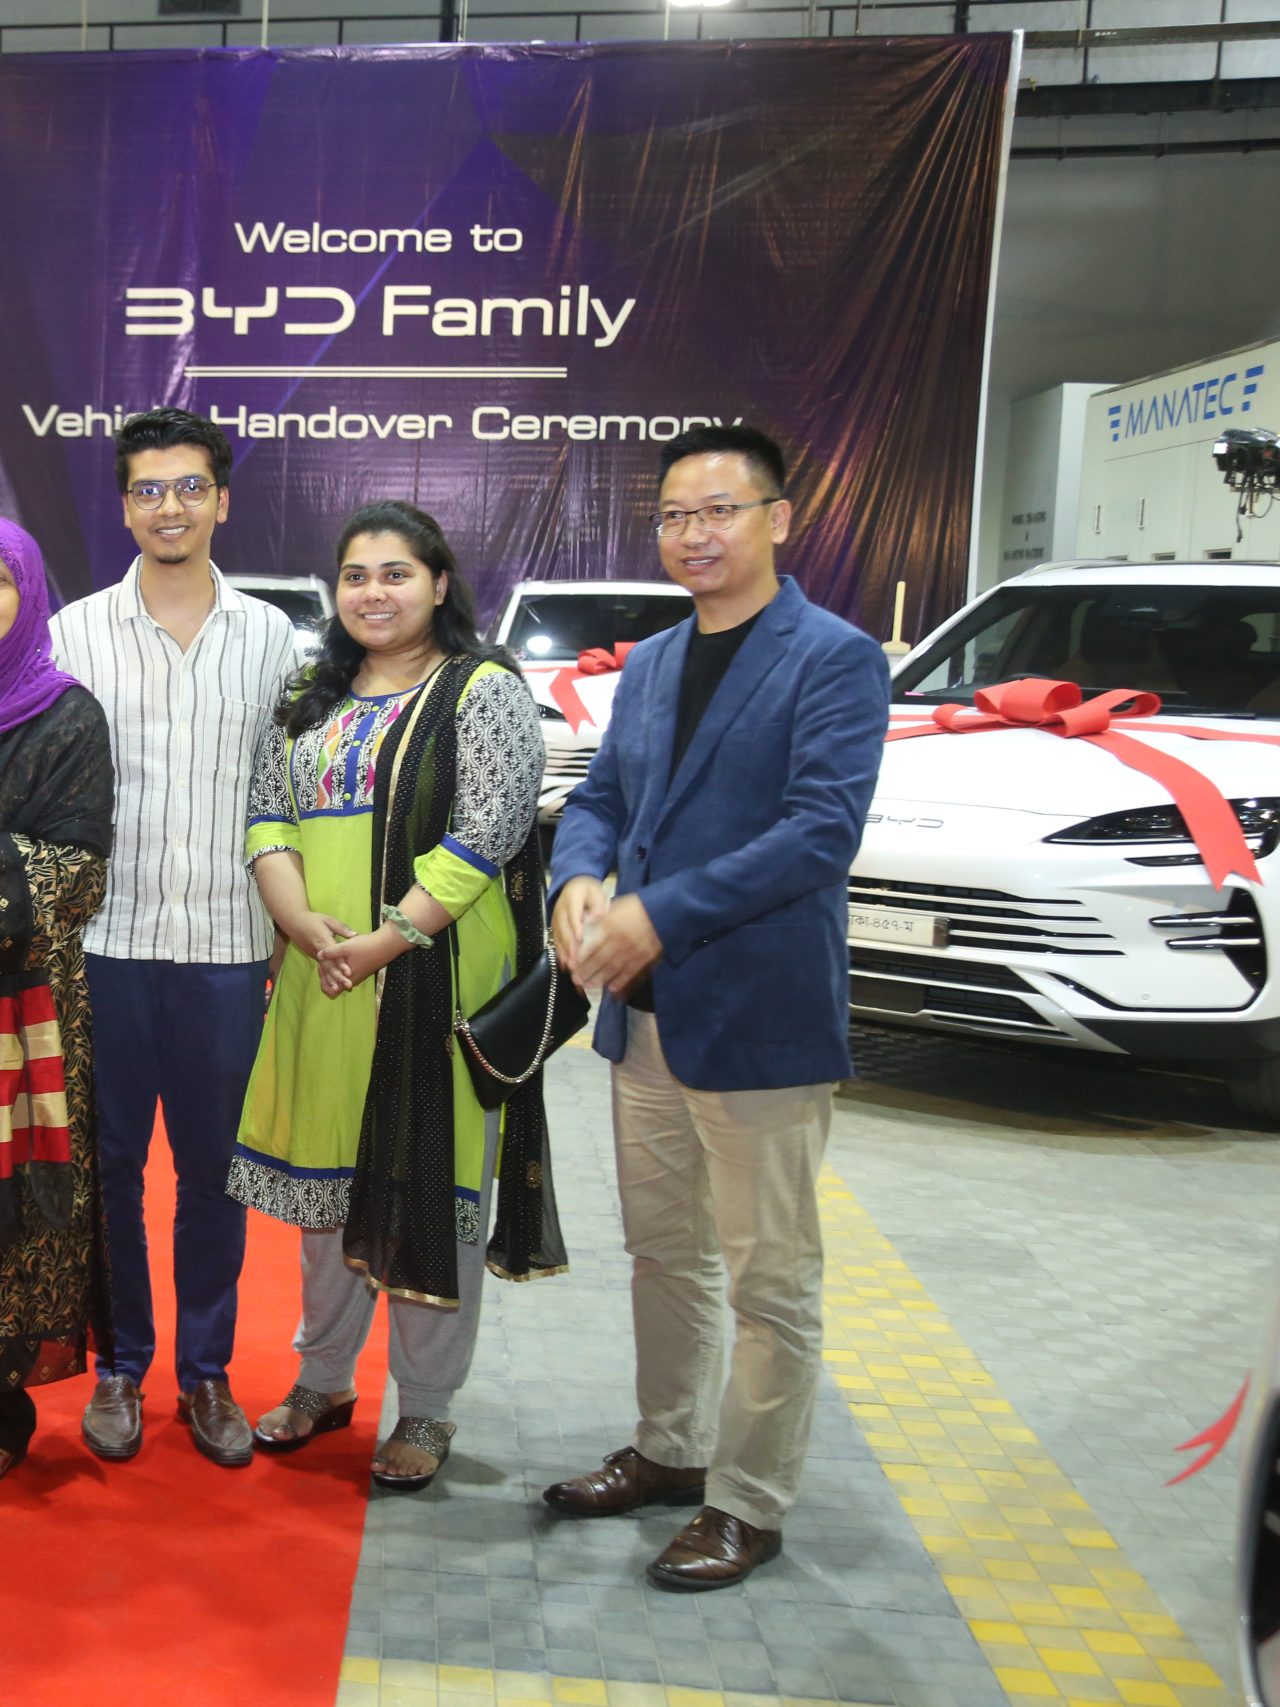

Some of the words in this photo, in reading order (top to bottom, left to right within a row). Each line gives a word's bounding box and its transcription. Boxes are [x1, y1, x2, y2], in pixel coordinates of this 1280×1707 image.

[234, 222, 452, 253] Welcome
[470, 224, 523, 252] to
[125, 286, 356, 335] BYD
[382, 285, 636, 347] Family
[22, 404, 161, 437] Vehi
[210, 405, 452, 440] Handover
[1125, 373, 1237, 439] MANATEC
